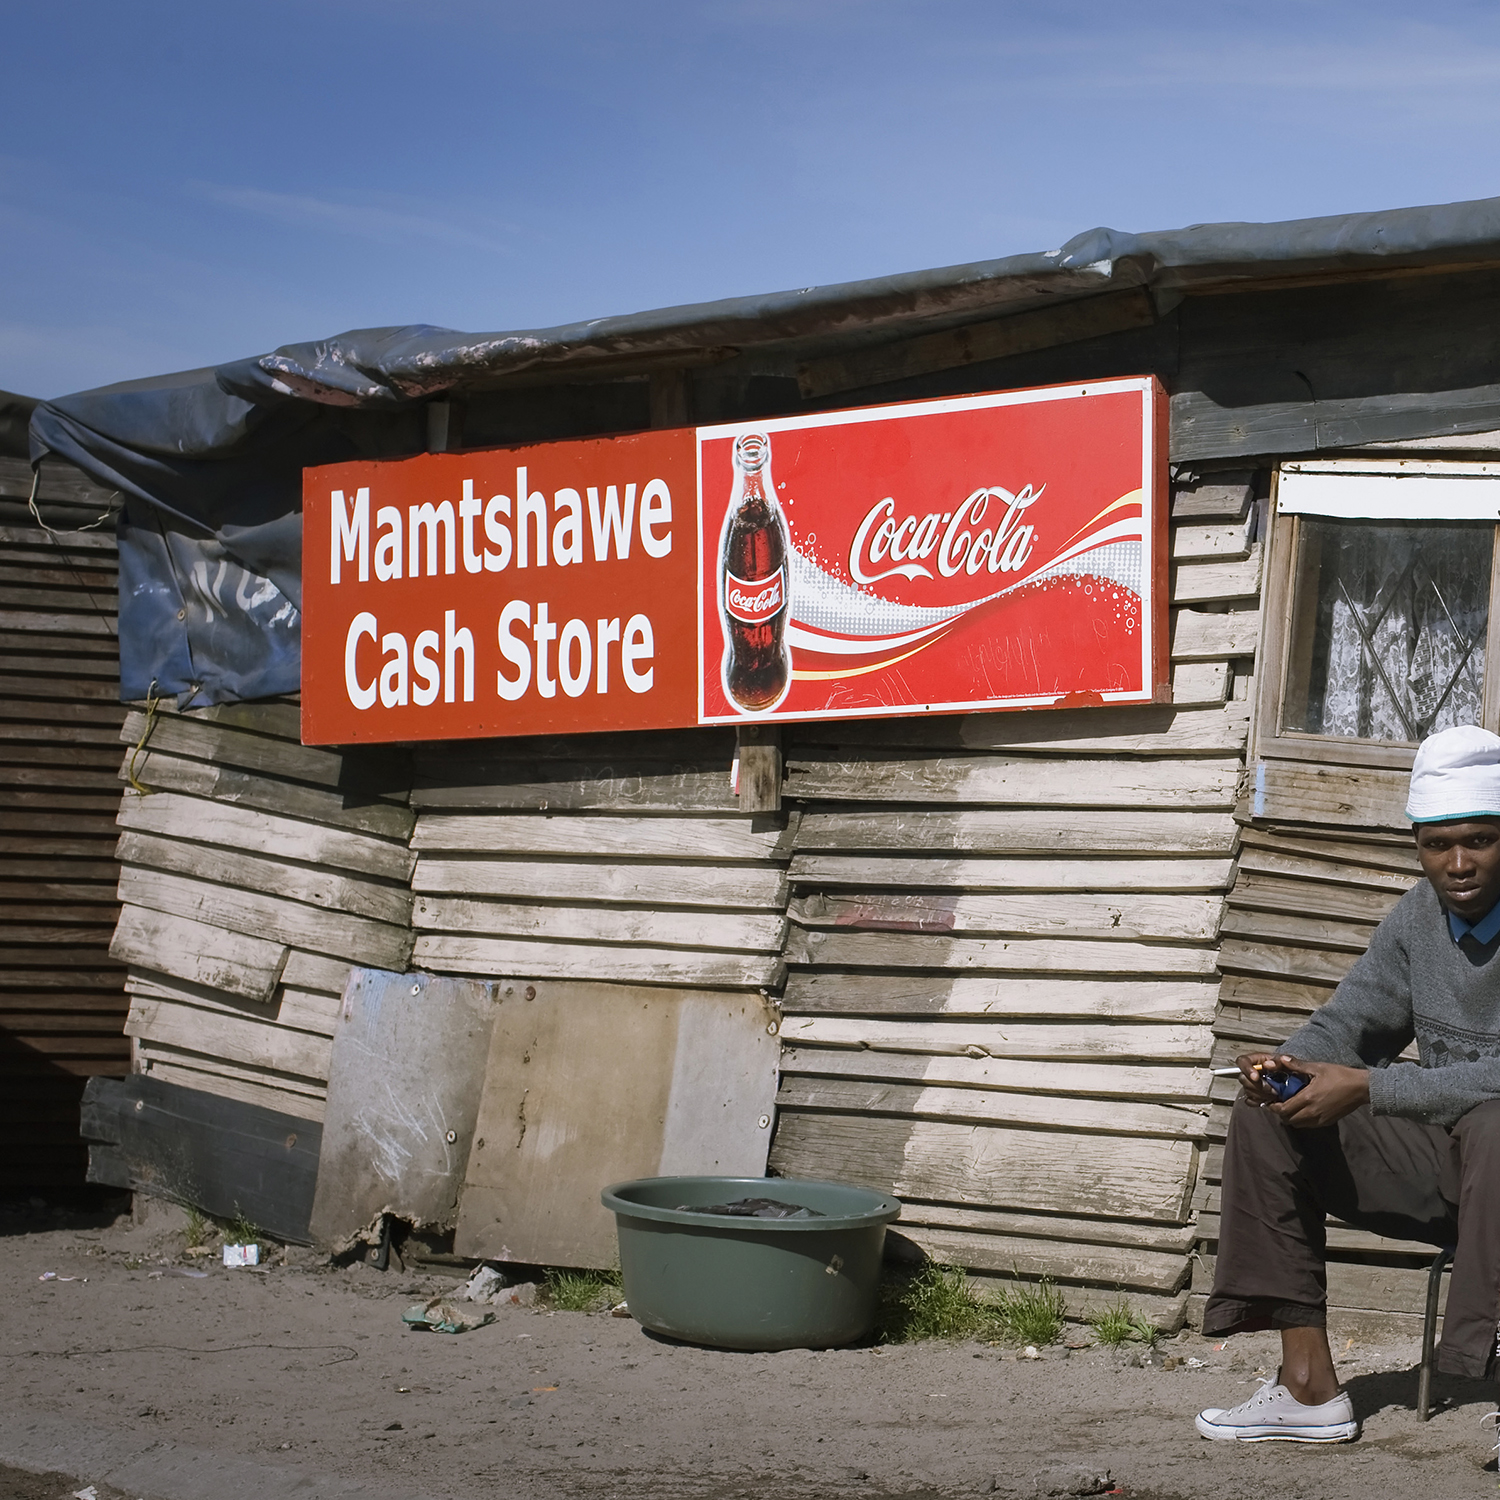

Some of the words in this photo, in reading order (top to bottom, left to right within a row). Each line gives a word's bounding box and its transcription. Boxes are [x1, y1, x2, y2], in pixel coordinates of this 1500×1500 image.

[330, 466, 673, 585] Mamtshawe
[850, 483, 1047, 581] Coca-Cola
[729, 581, 780, 613] Coca-Cola
[344, 611, 475, 710] Cash
[497, 599, 654, 701] Store
